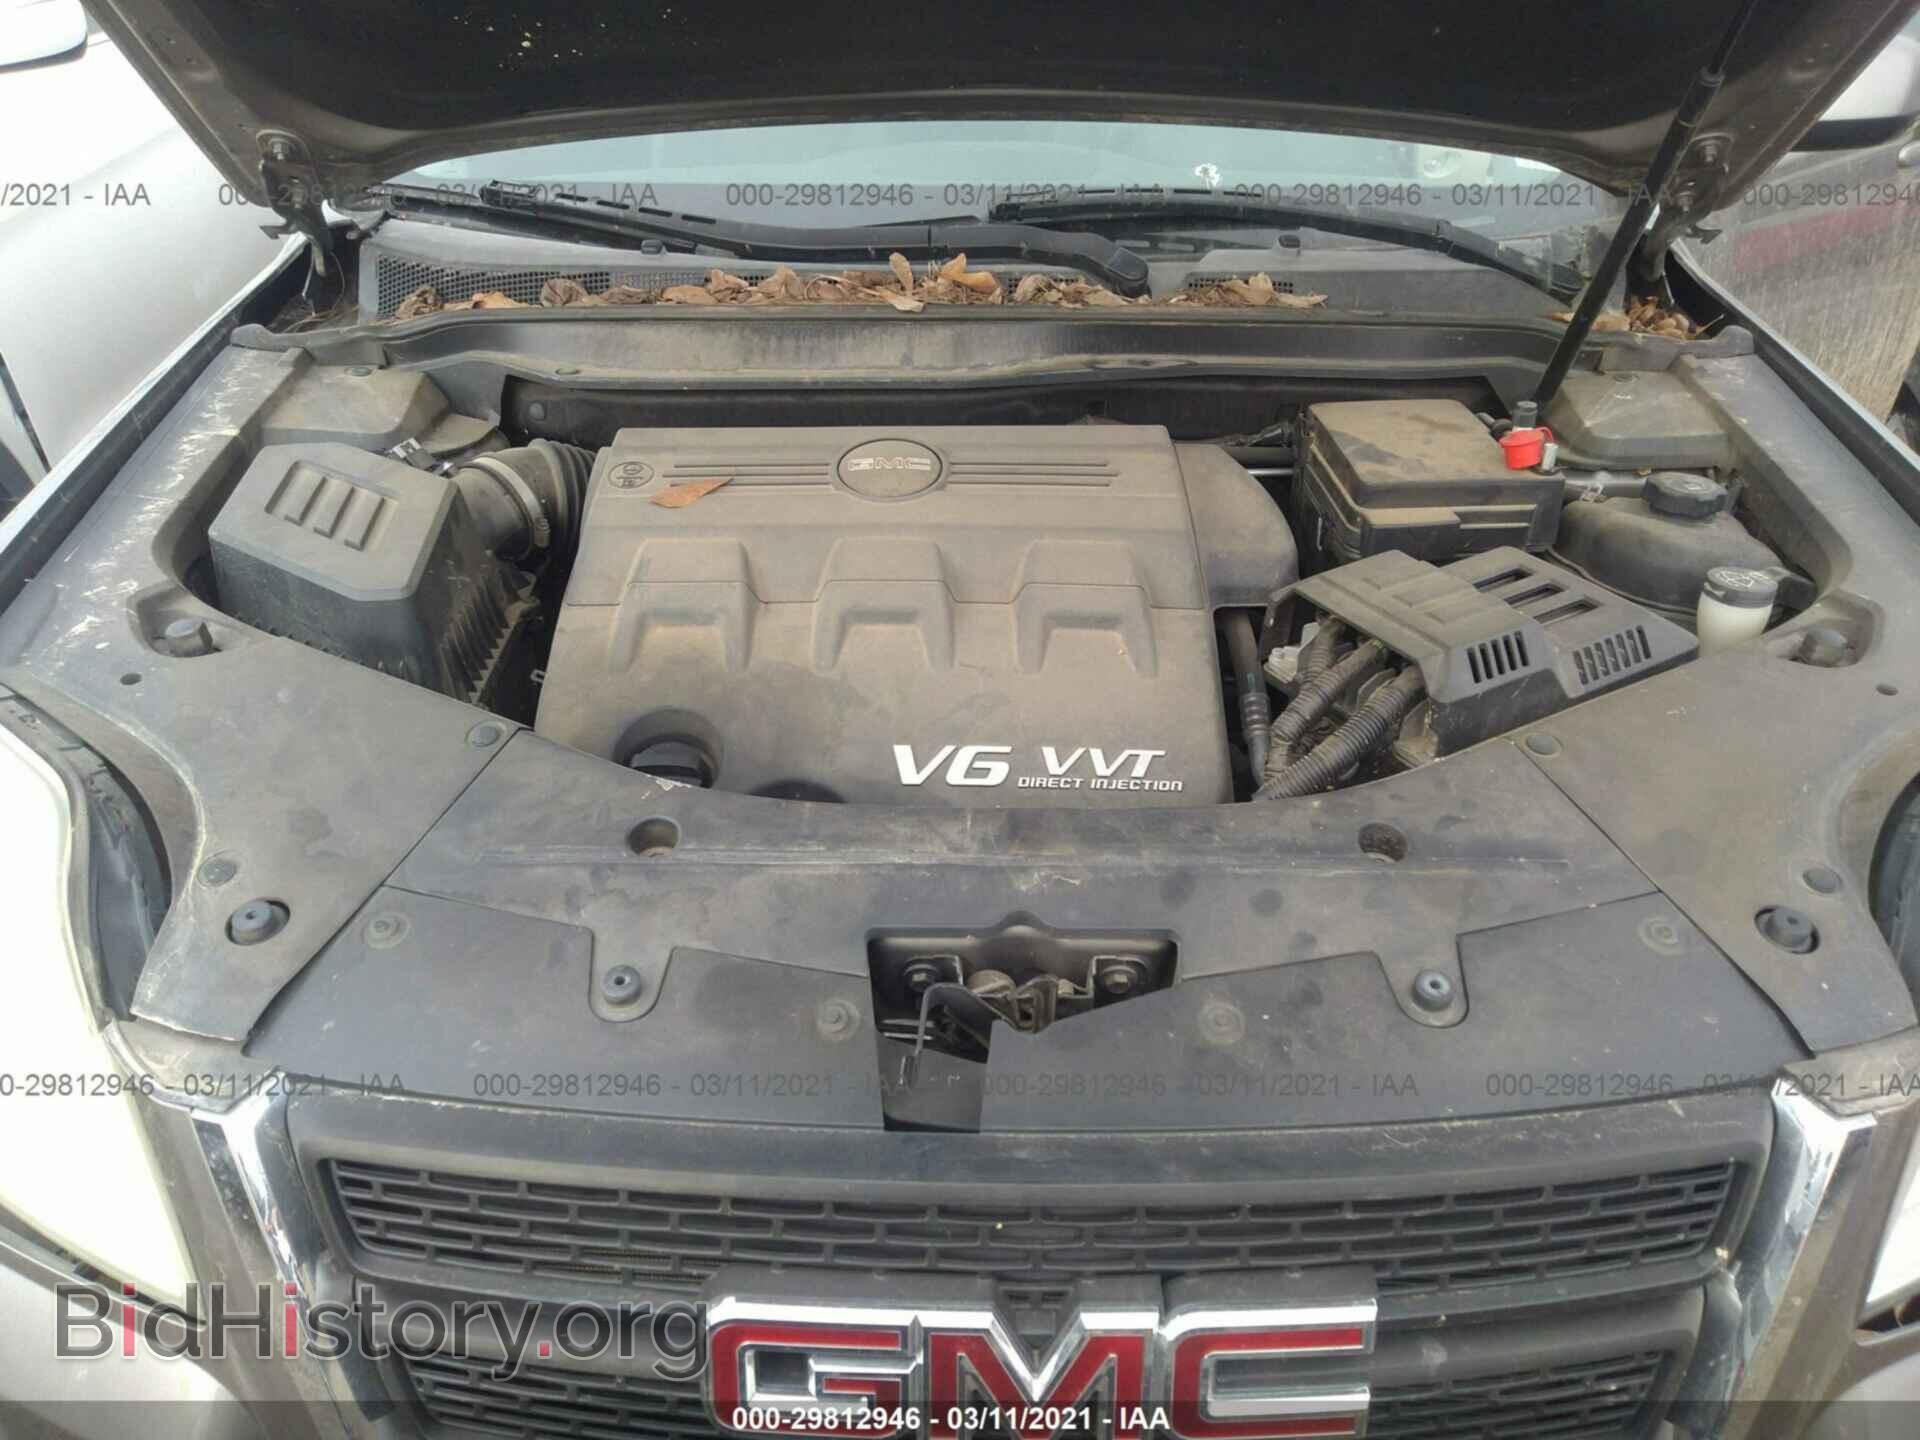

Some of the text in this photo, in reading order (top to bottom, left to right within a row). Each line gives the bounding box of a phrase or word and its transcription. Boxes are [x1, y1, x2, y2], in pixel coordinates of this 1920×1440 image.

[847, 456, 931, 472] GMC
[893, 744, 1166, 786] V6 VVT
[1017, 776, 1184, 792] DIRECT INJECTION
[705, 1296, 1378, 1440] GMC
